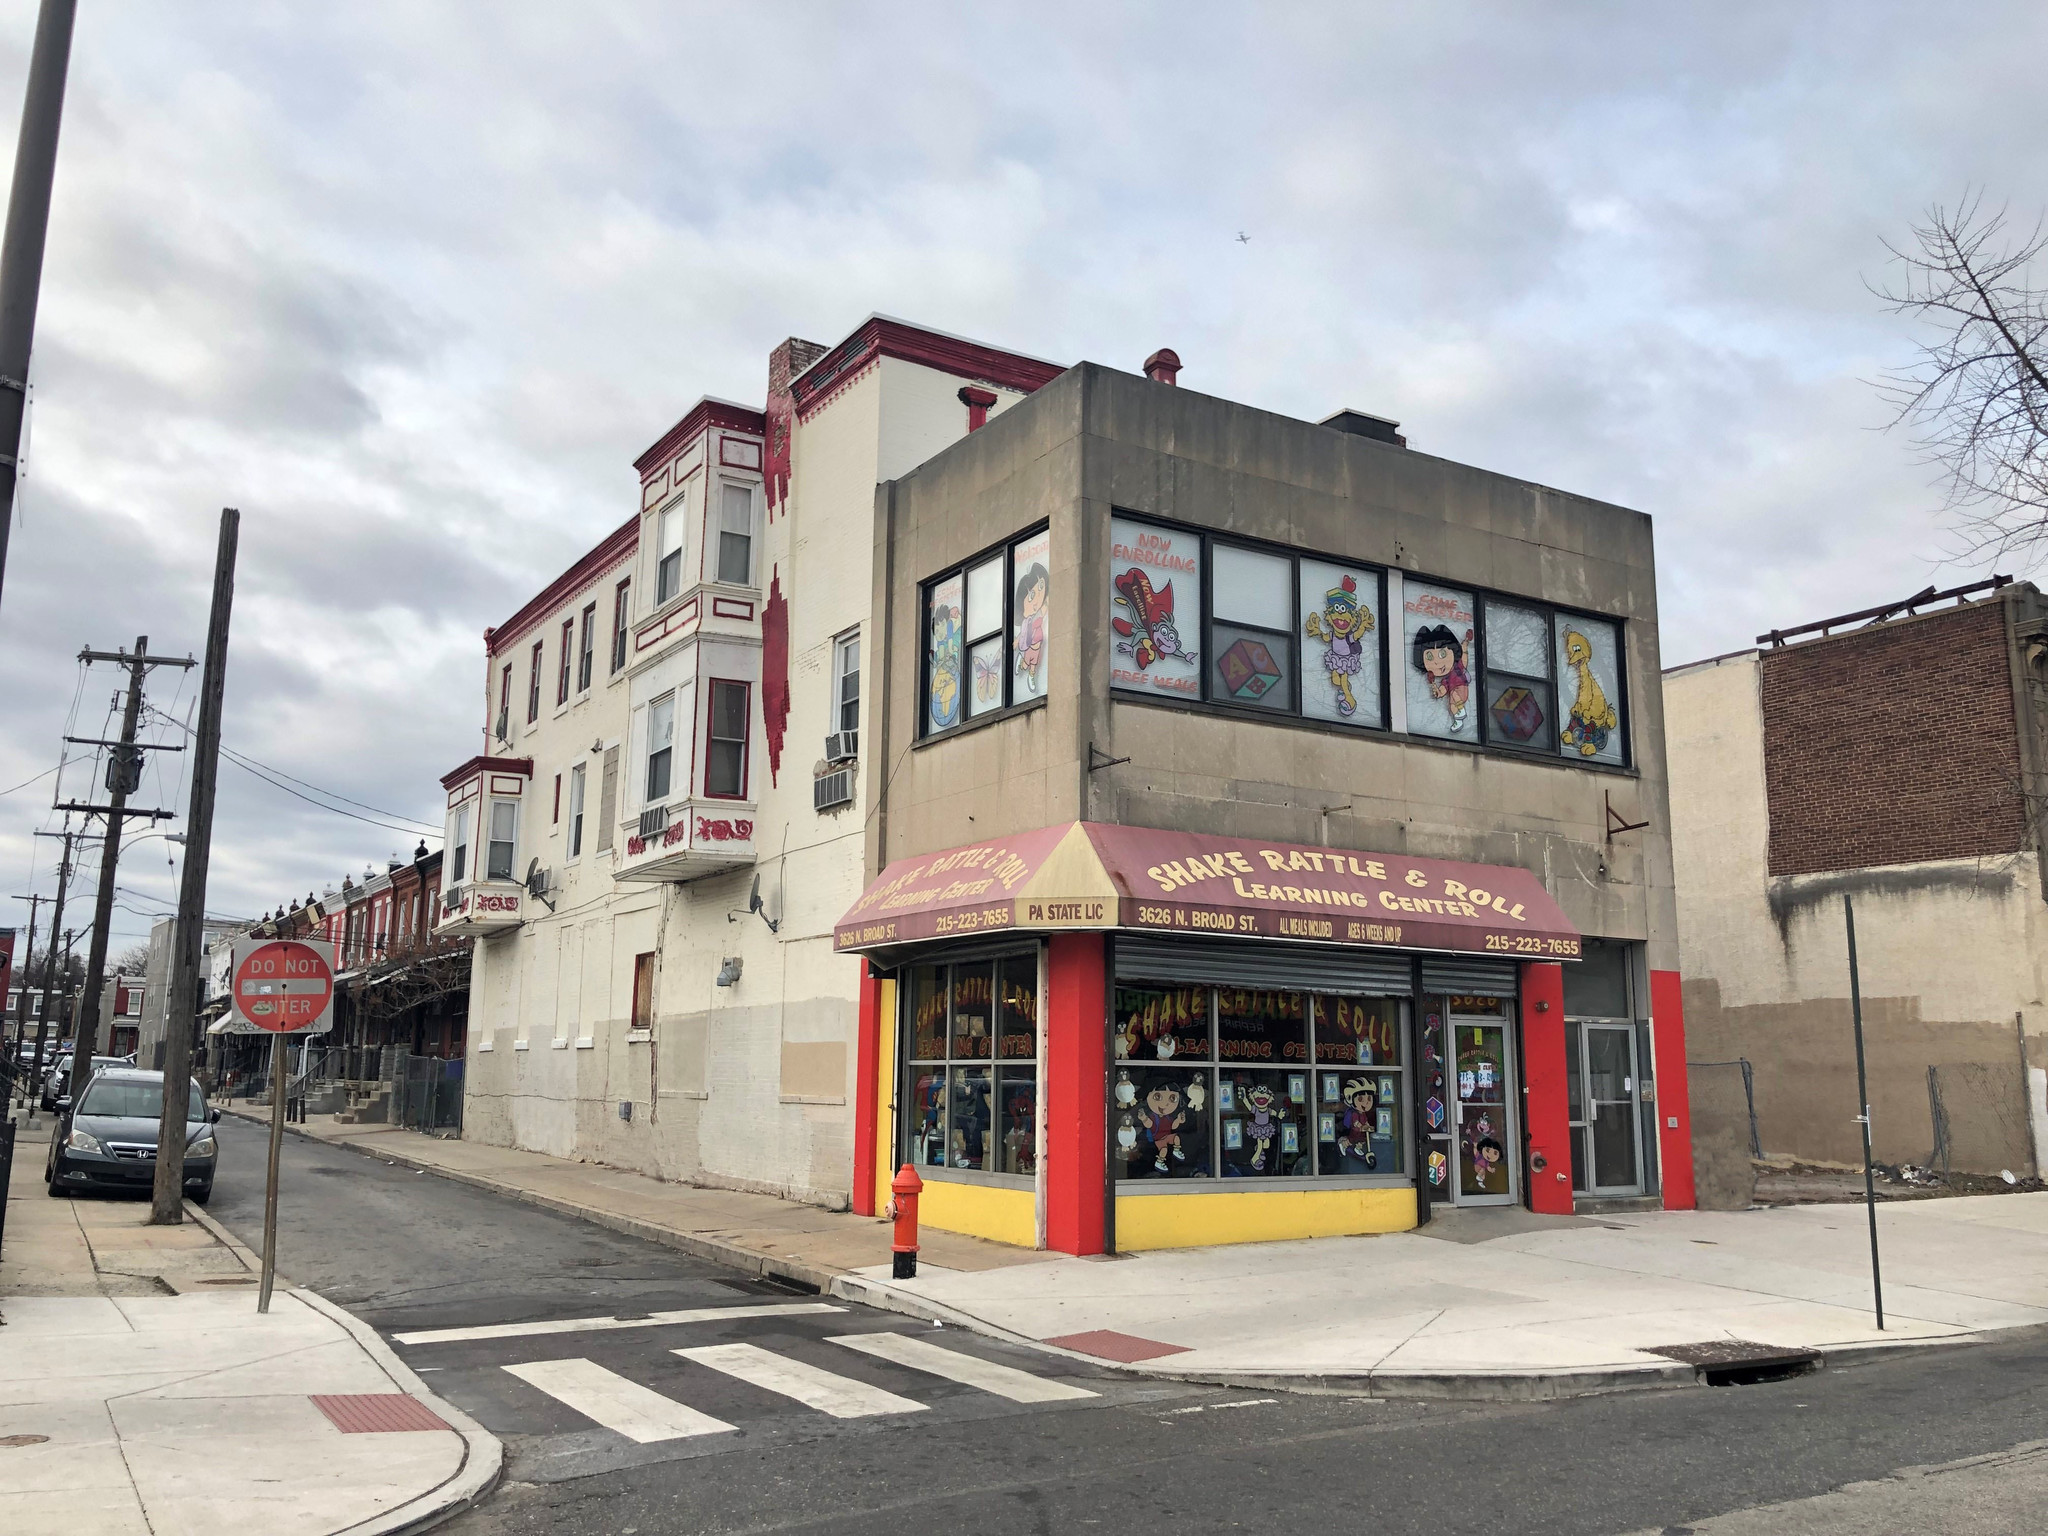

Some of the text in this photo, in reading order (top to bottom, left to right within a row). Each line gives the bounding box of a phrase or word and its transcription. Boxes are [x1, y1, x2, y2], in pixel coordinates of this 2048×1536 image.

[1138, 533, 1171, 551] NOW
[1113, 544, 1196, 573] ENROLLING
[1139, 578, 1154, 604] Now
[1420, 594, 1458, 609] COME
[1405, 601, 1473, 622] REGISTER
[1112, 668, 1198, 693] FREE MEALS
[852, 847, 1028, 916] SHAKE RATTLE & ROLL
[1147, 850, 1527, 922] SHAKE RATTLE & ROLL
[878, 878, 994, 911] LEARNING CENTER
[1233, 876, 1480, 919] LEARNING CENTER
[936, 907, 1009, 932] 215-223-7655
[1029, 903, 1103, 921] PA STATE LIC
[1138, 906, 1259, 931] 3626 N. BROAD ST.
[839, 923, 896, 947] 3626 N. BROAD ST.
[1280, 917, 1333, 938] ALL MEALS INCLUDED
[1348, 922, 1361, 939] AGES
[1366, 924, 1383, 941] WEEKS
[1384, 925, 1394, 942] AND
[1485, 934, 1579, 955] 215-223-7655
[251, 960, 319, 973] DO NOT
[1126, 986, 1205, 1054] SHAKE
[1337, 998, 1392, 1057] ROLL
[1173, 1036, 1273, 1058] LEARNING
